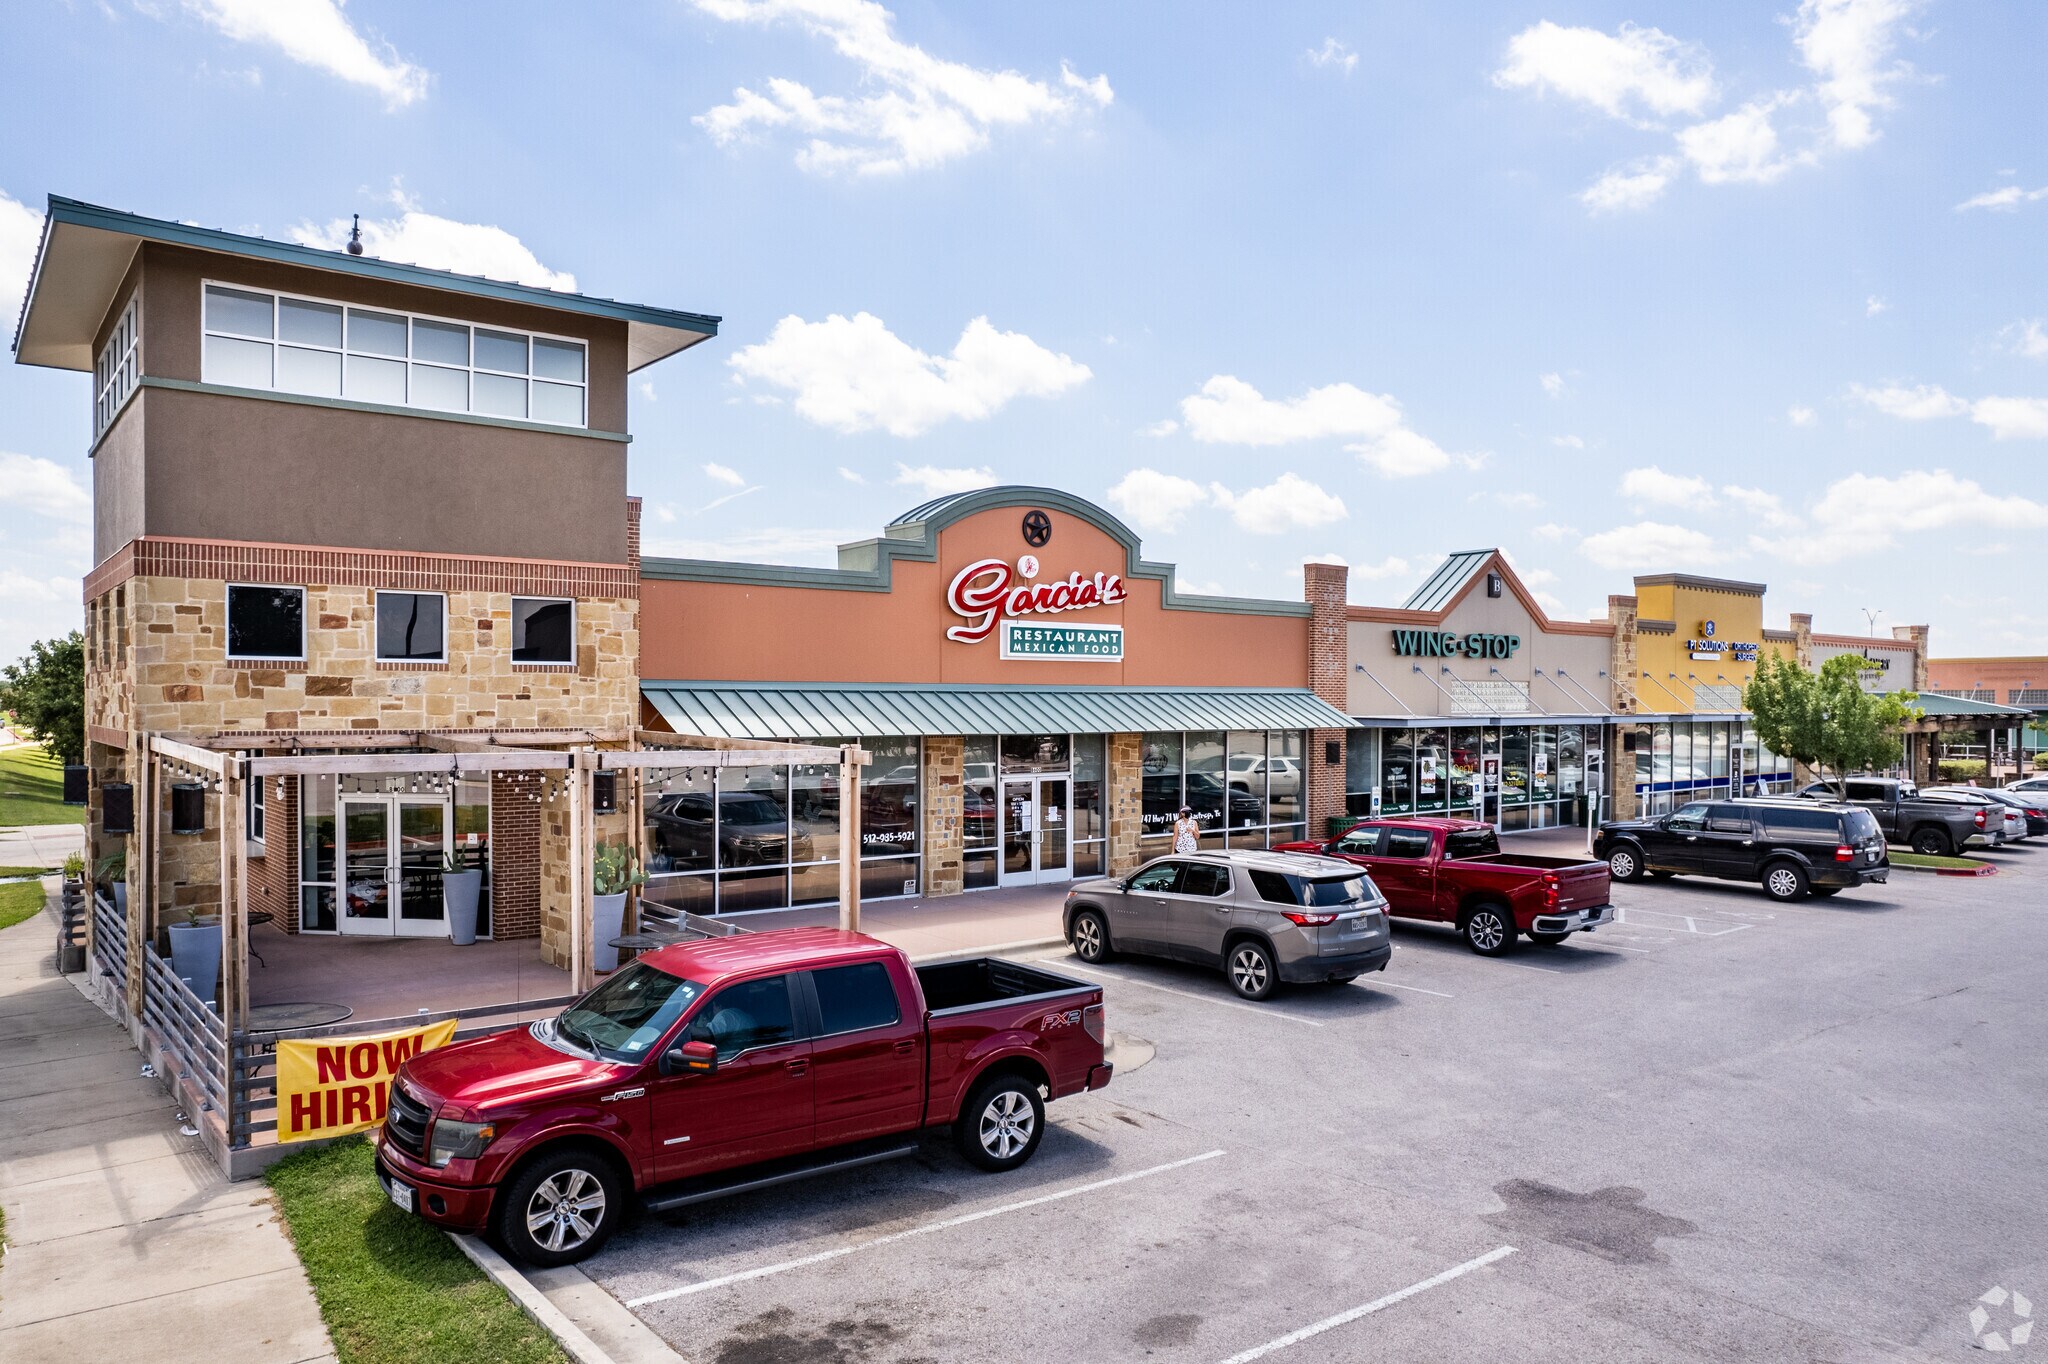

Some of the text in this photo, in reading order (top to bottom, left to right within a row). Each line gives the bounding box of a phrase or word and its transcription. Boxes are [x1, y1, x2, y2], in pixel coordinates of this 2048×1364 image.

[1494, 579, 1501, 592] B
[947, 557, 1128, 644] Garcia's
[1013, 629, 1119, 644] RESTAURANT
[1392, 630, 1521, 659] WING STOP
[1689, 640, 1729, 652] PT SOLUTIONS
[1013, 642, 1119, 654] MEXICAN FOOD
[1041, 1009, 1082, 1029] FX2
[316, 1034, 425, 1085] NOW
[290, 1081, 394, 1133] HIRI
